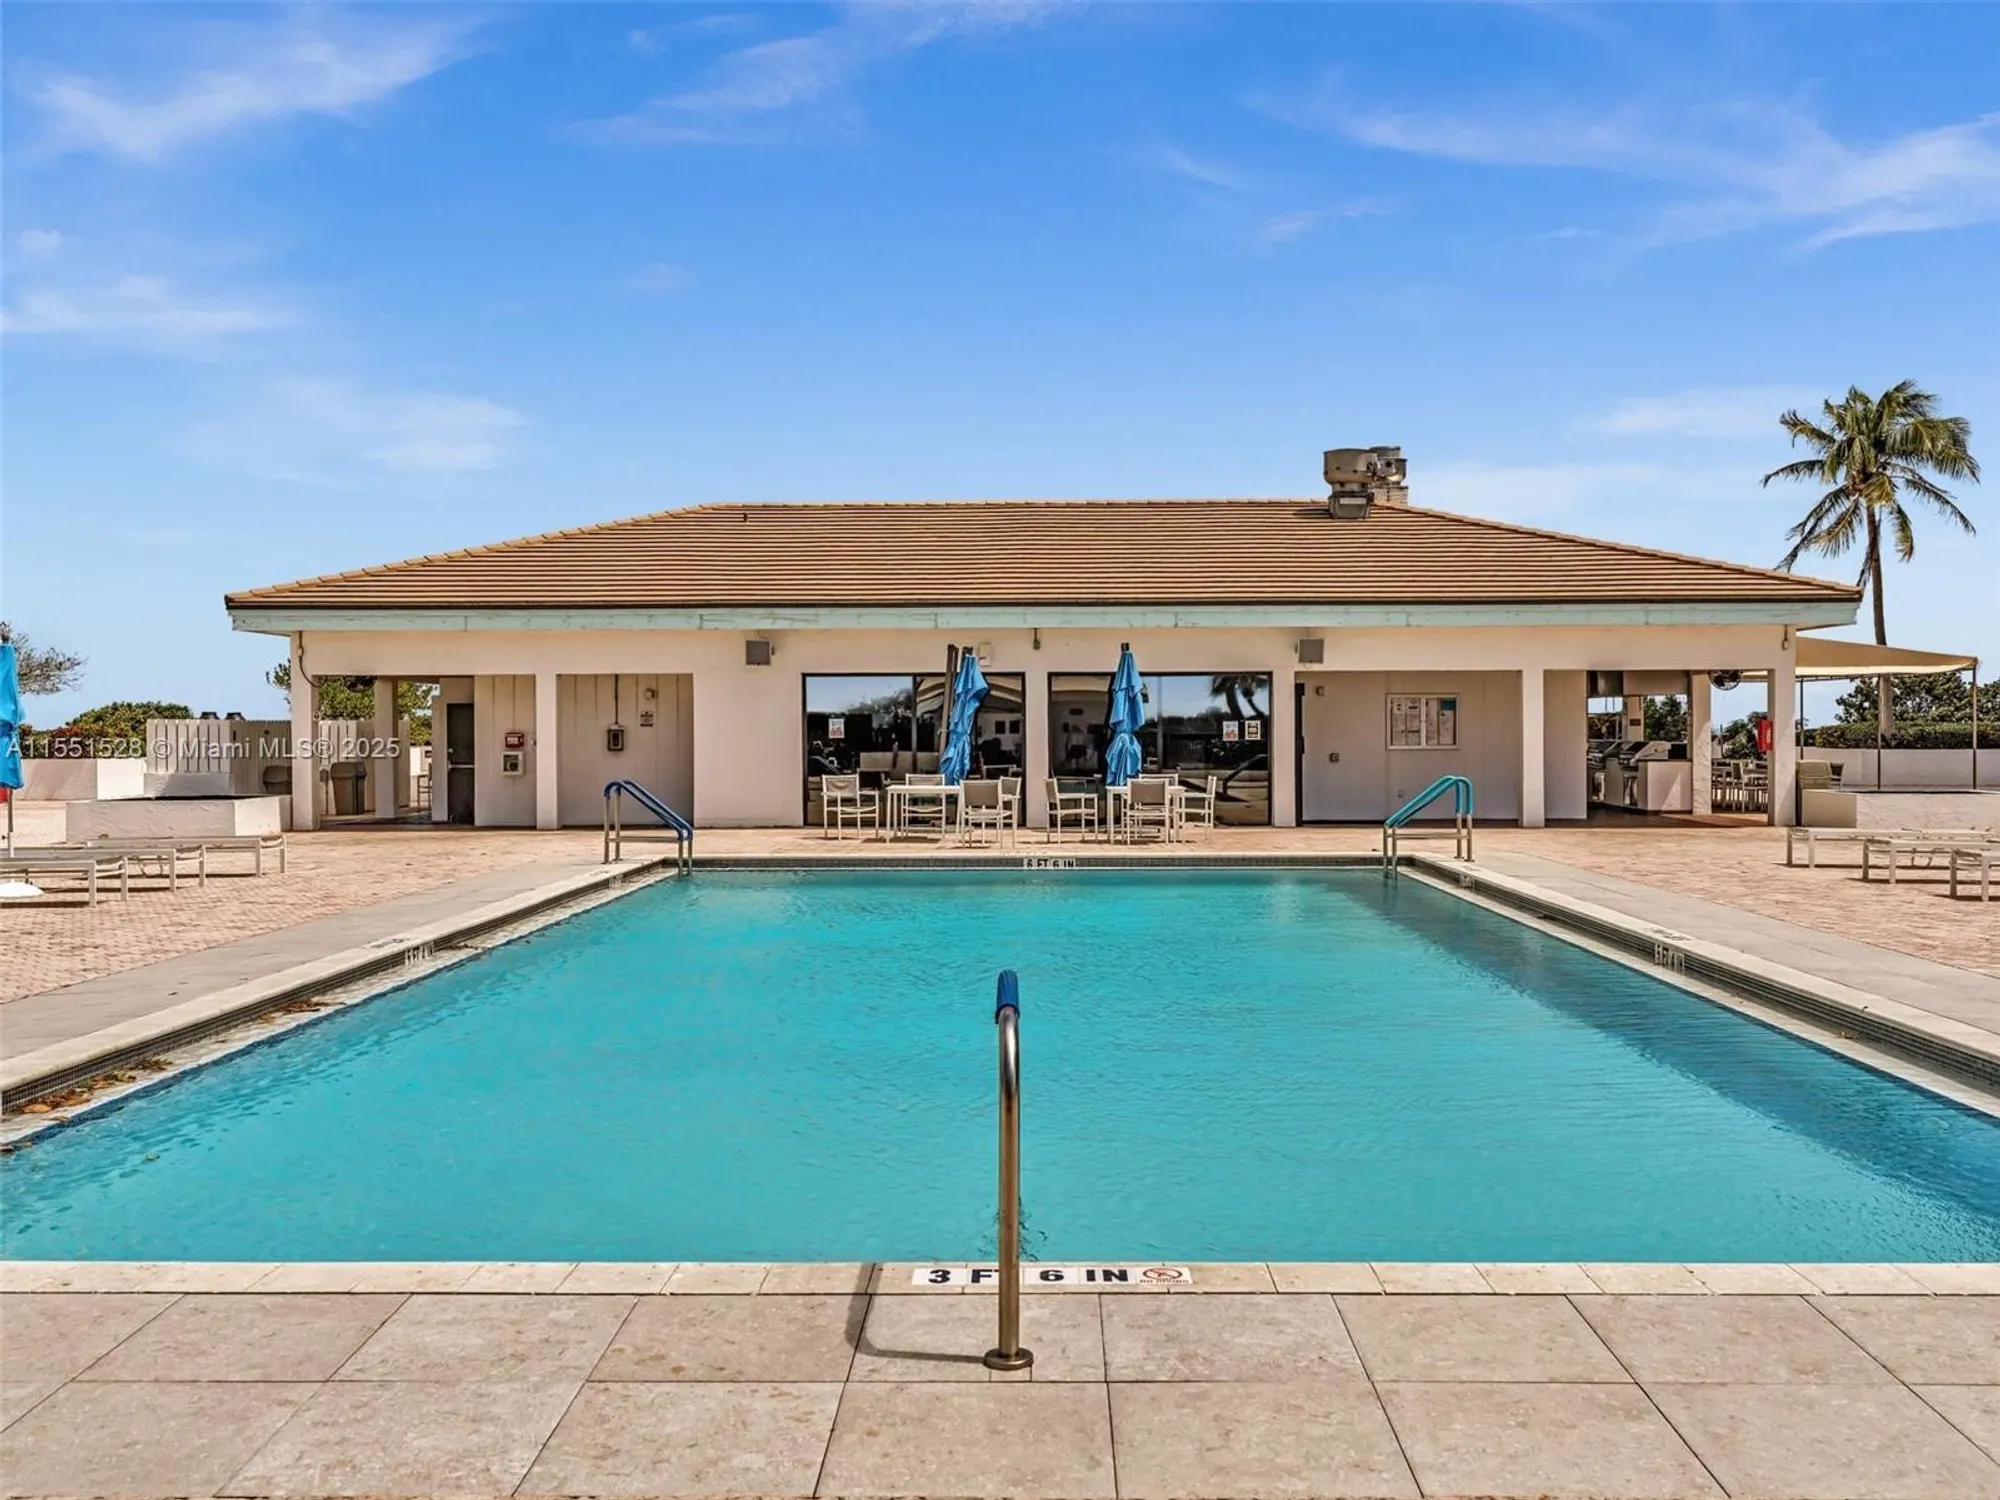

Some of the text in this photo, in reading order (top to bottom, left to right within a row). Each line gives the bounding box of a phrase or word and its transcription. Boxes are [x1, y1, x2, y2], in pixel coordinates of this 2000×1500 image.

[1037, 858, 1048, 868] FT
[1063, 859, 1074, 868] IN
[928, 1269, 951, 1284] 3
[1039, 1269, 1065, 1282] 6
[1086, 1269, 1128, 1282] IN
